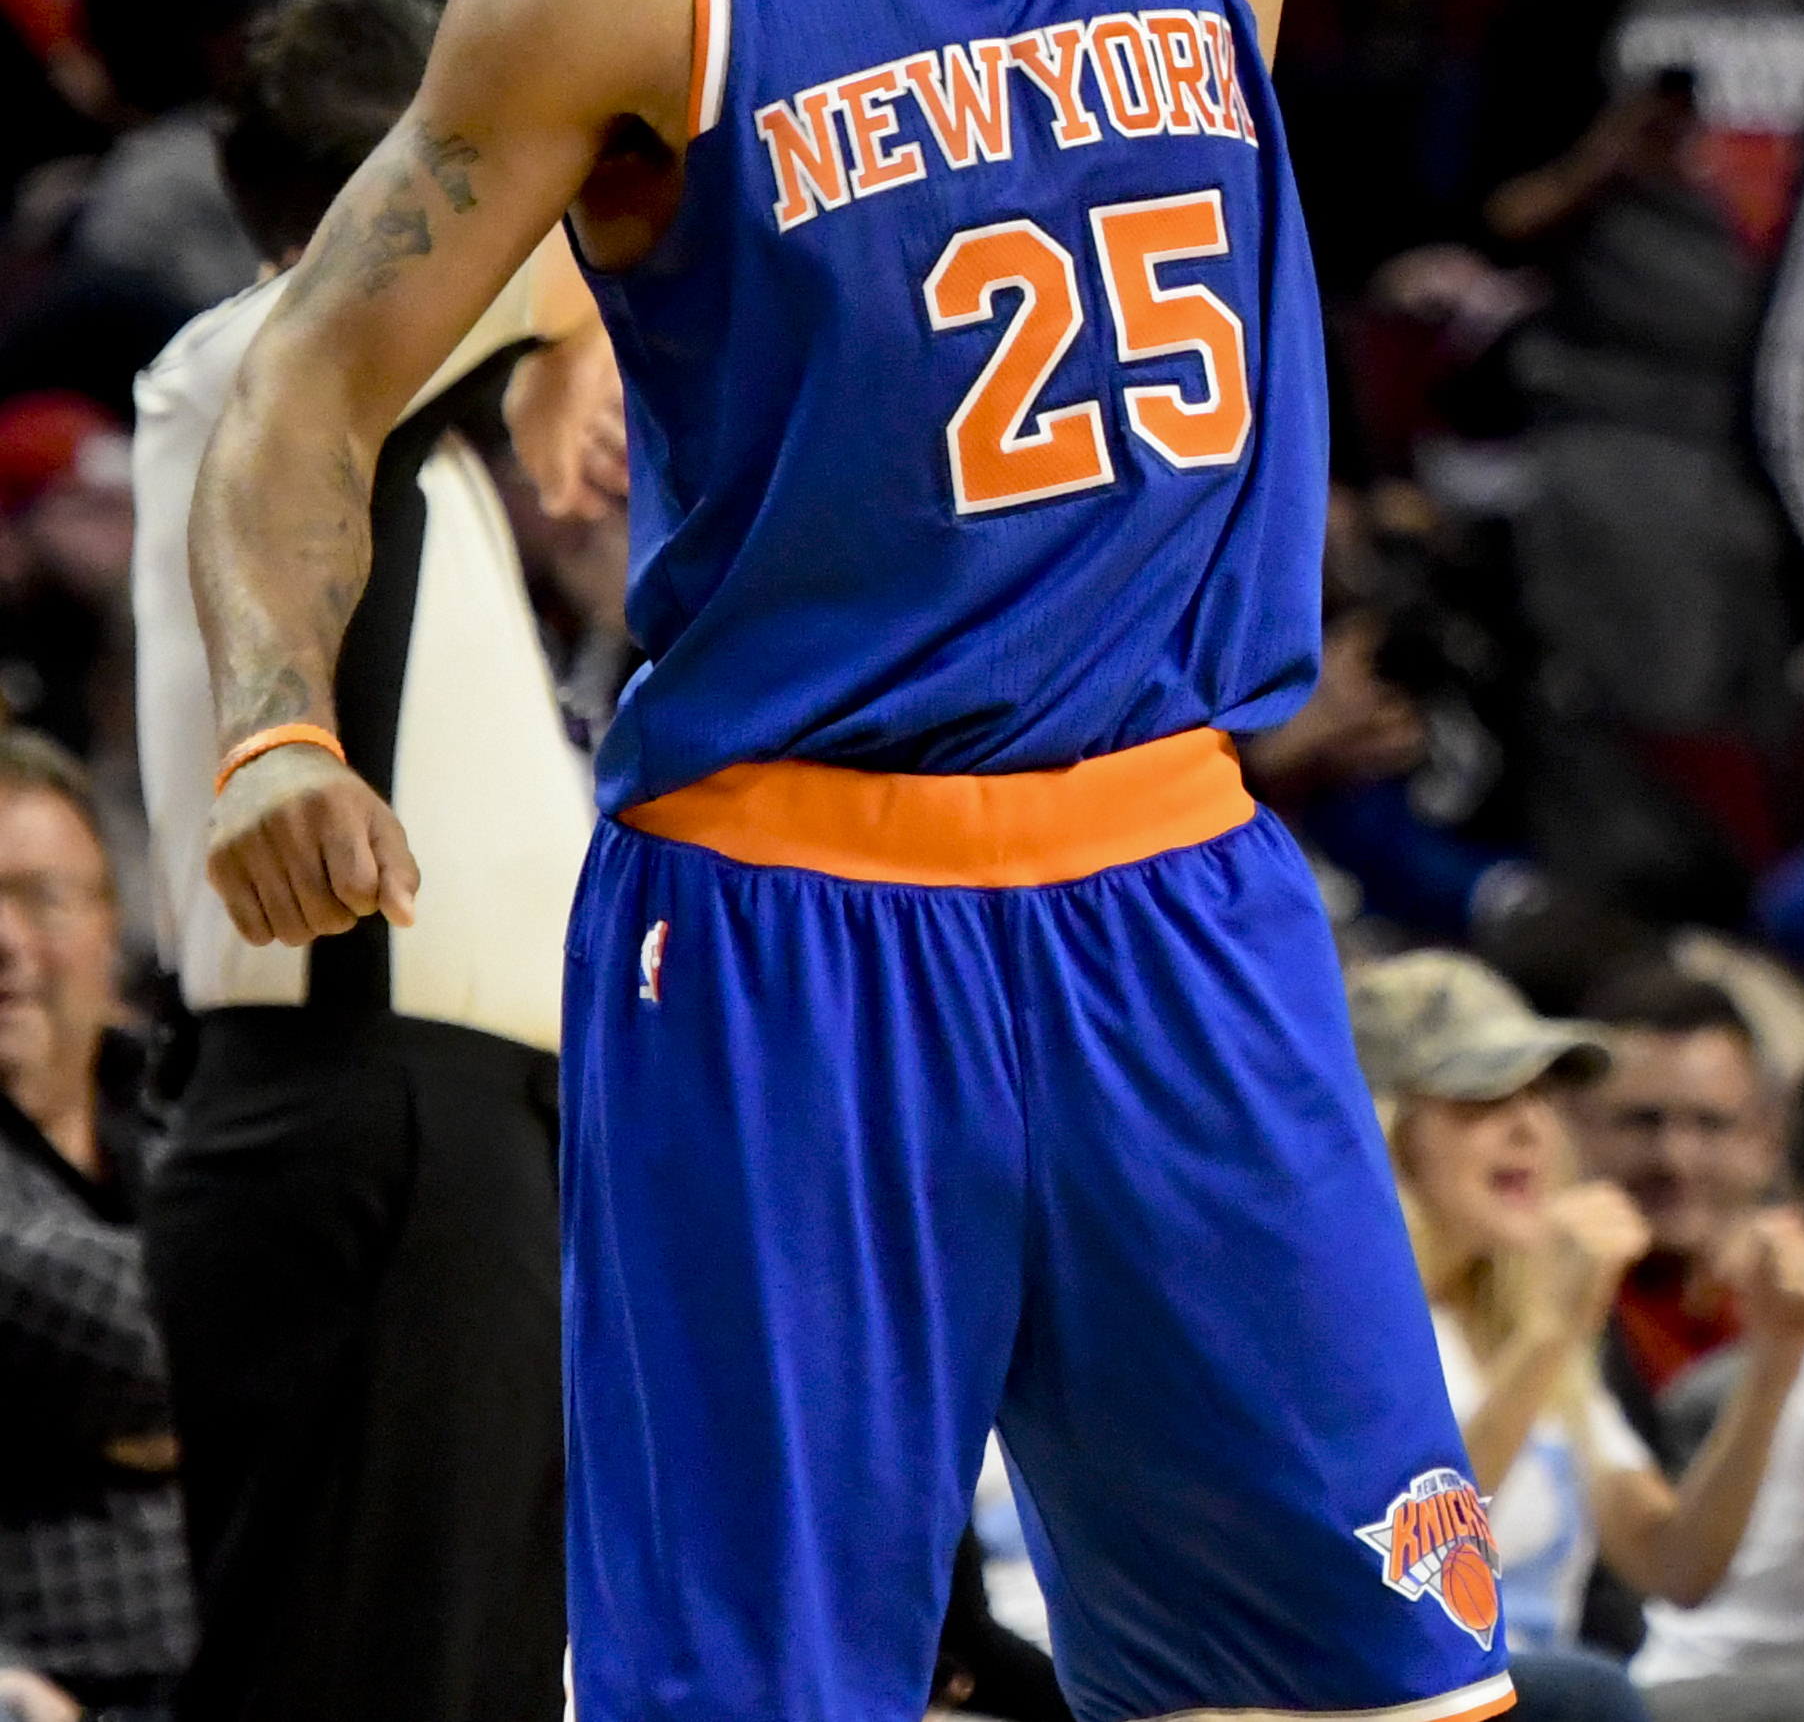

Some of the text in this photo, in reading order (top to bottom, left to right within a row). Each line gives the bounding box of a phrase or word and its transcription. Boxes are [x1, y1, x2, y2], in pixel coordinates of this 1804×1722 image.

[754, 9, 1259, 233] NEW YORK
[923, 189, 1252, 515] 25
